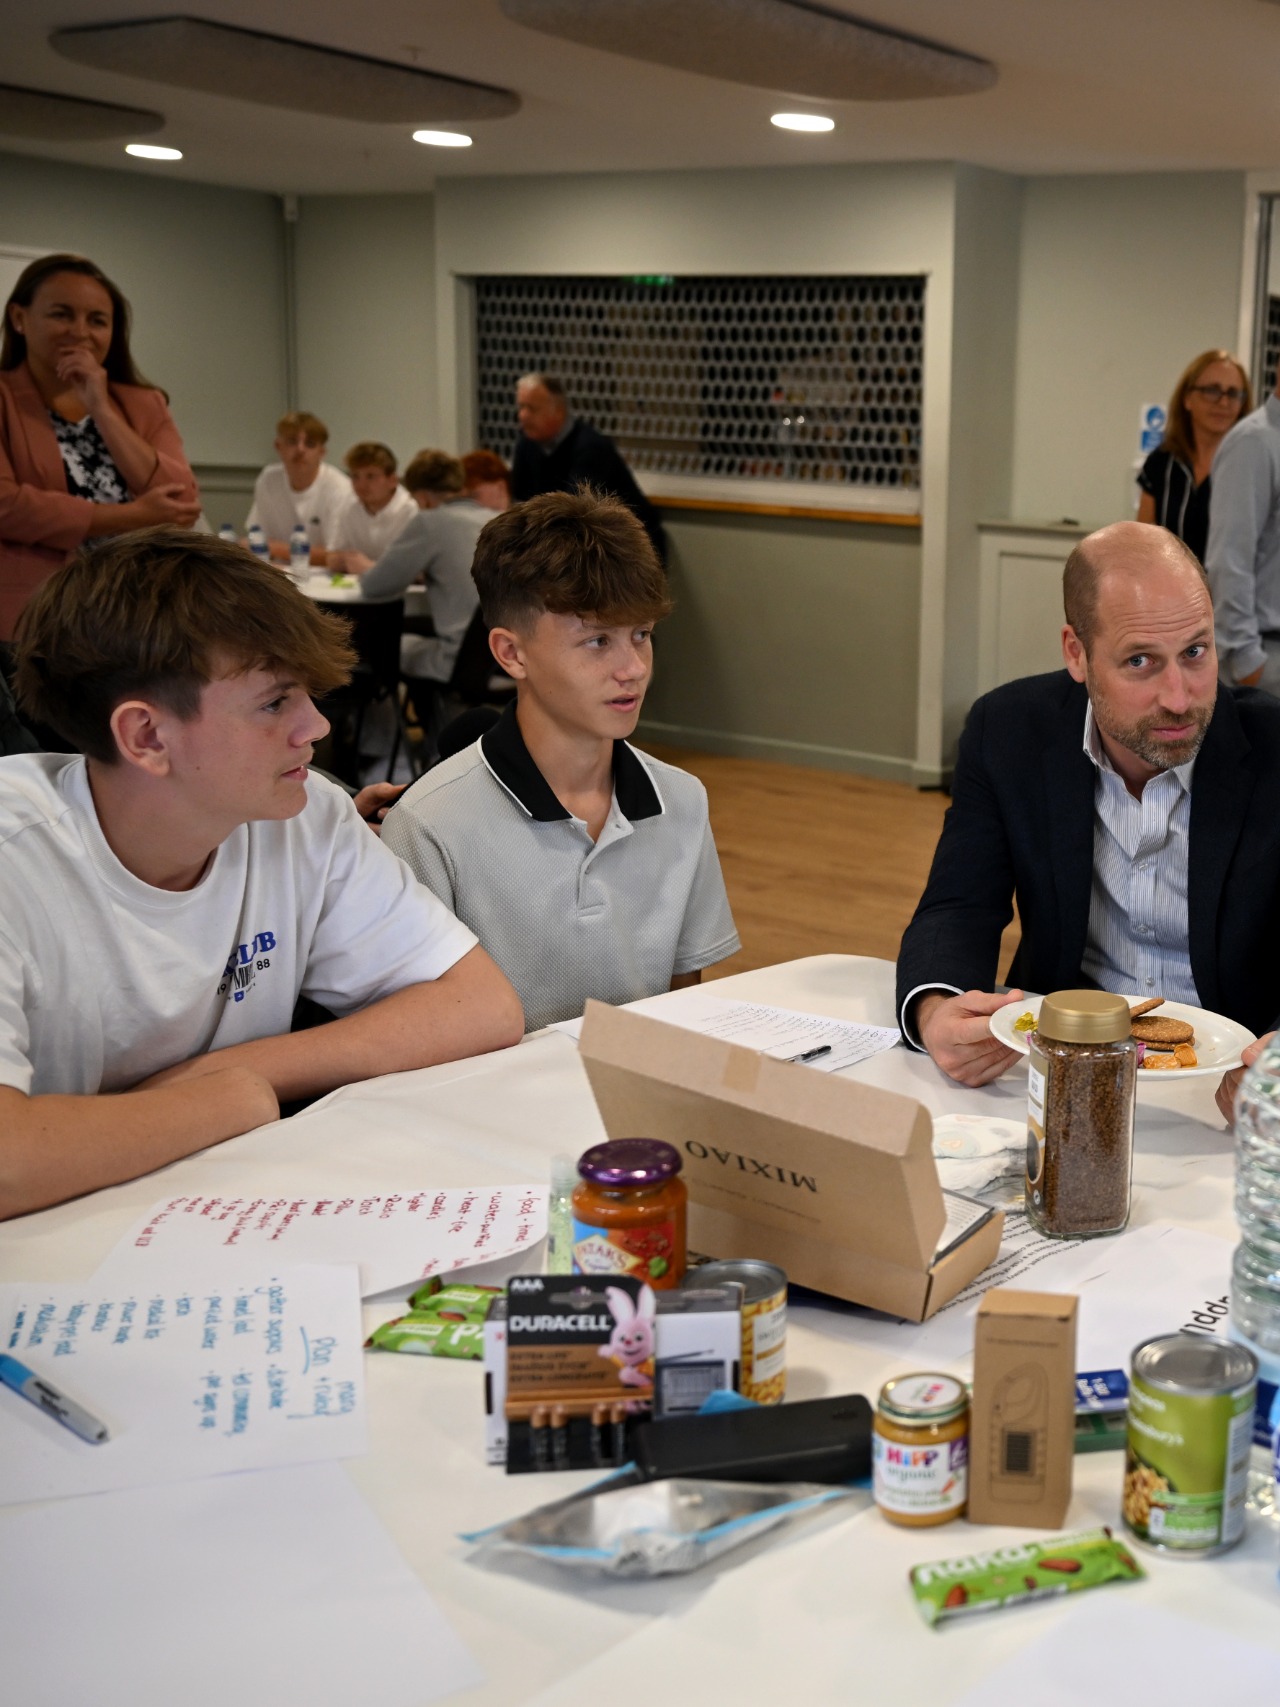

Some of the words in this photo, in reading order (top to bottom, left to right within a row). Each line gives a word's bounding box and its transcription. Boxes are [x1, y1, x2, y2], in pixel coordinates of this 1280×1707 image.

[256, 958, 270, 970] 88
[685, 1140, 818, 1193] MIXIAO
[511, 1279, 544, 1293] AAA
[509, 1314, 612, 1333] DURACELL
[311, 1337, 338, 1366] Plan
